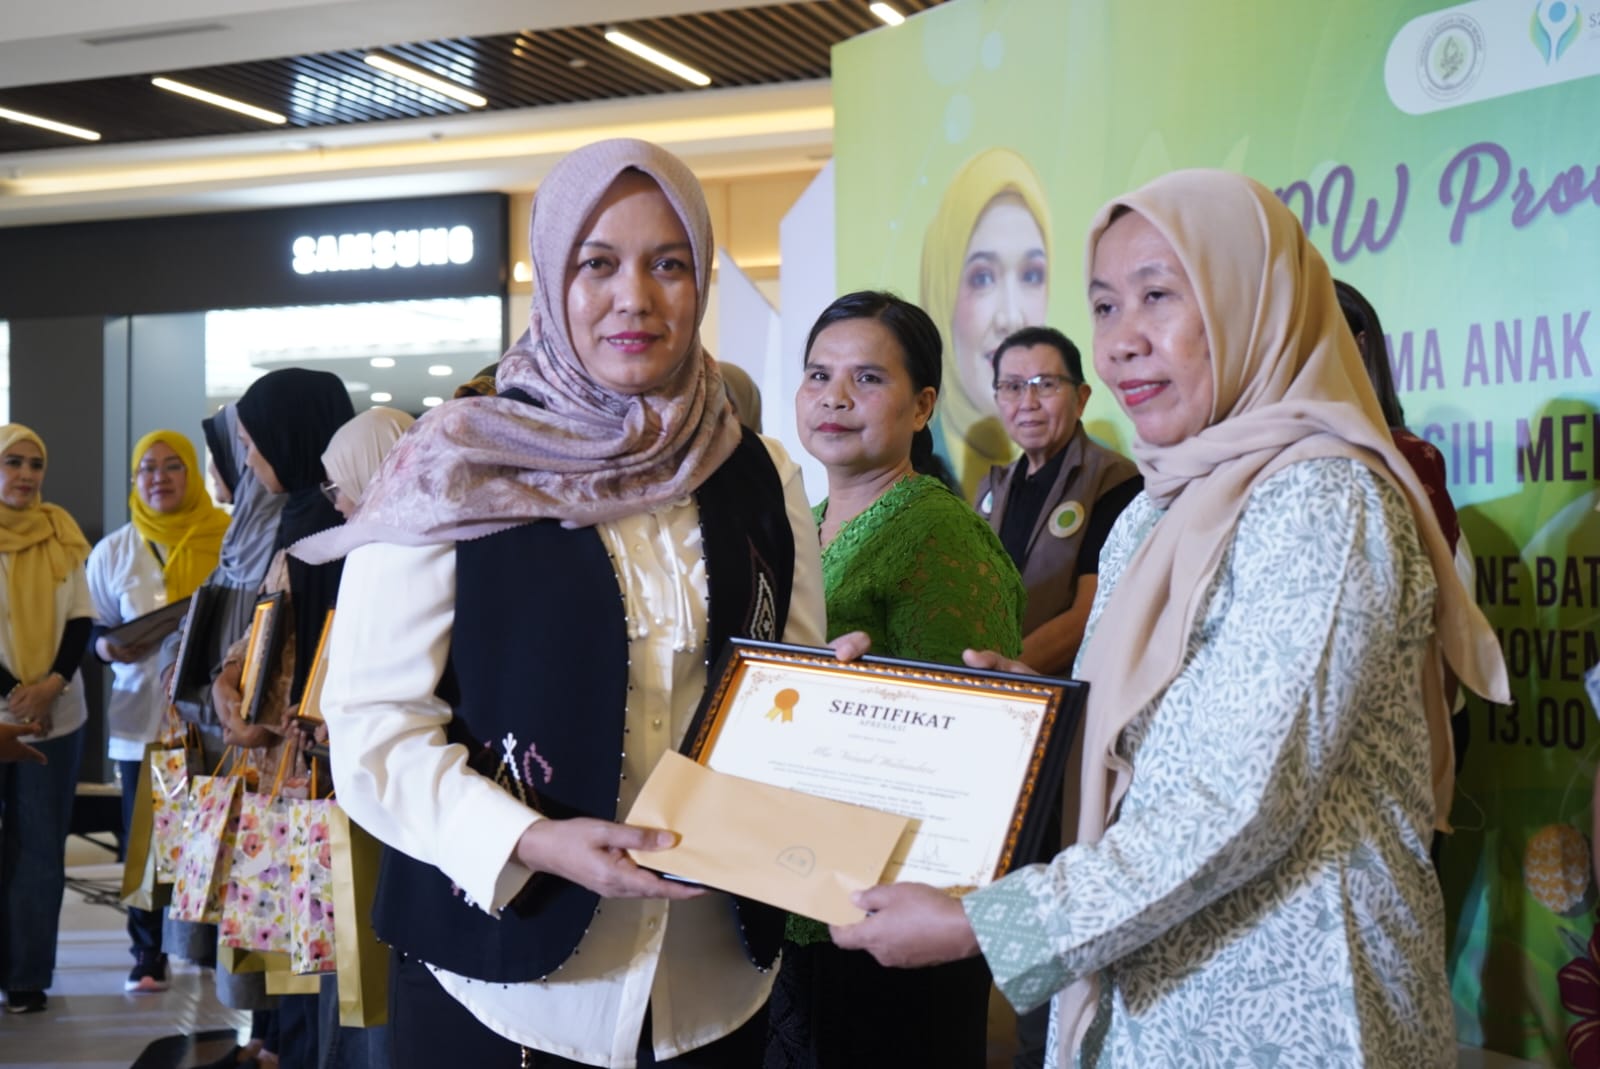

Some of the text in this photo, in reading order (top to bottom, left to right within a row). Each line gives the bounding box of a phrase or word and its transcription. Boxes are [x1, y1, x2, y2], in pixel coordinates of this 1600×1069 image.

[1438, 141, 1600, 246] Pro
[292, 225, 474, 275] SAMSUNG
[1463, 310, 1593, 388] ANAK
[828, 698, 956, 731] SERTIFIKAT
[1487, 697, 1586, 751] 13.00
